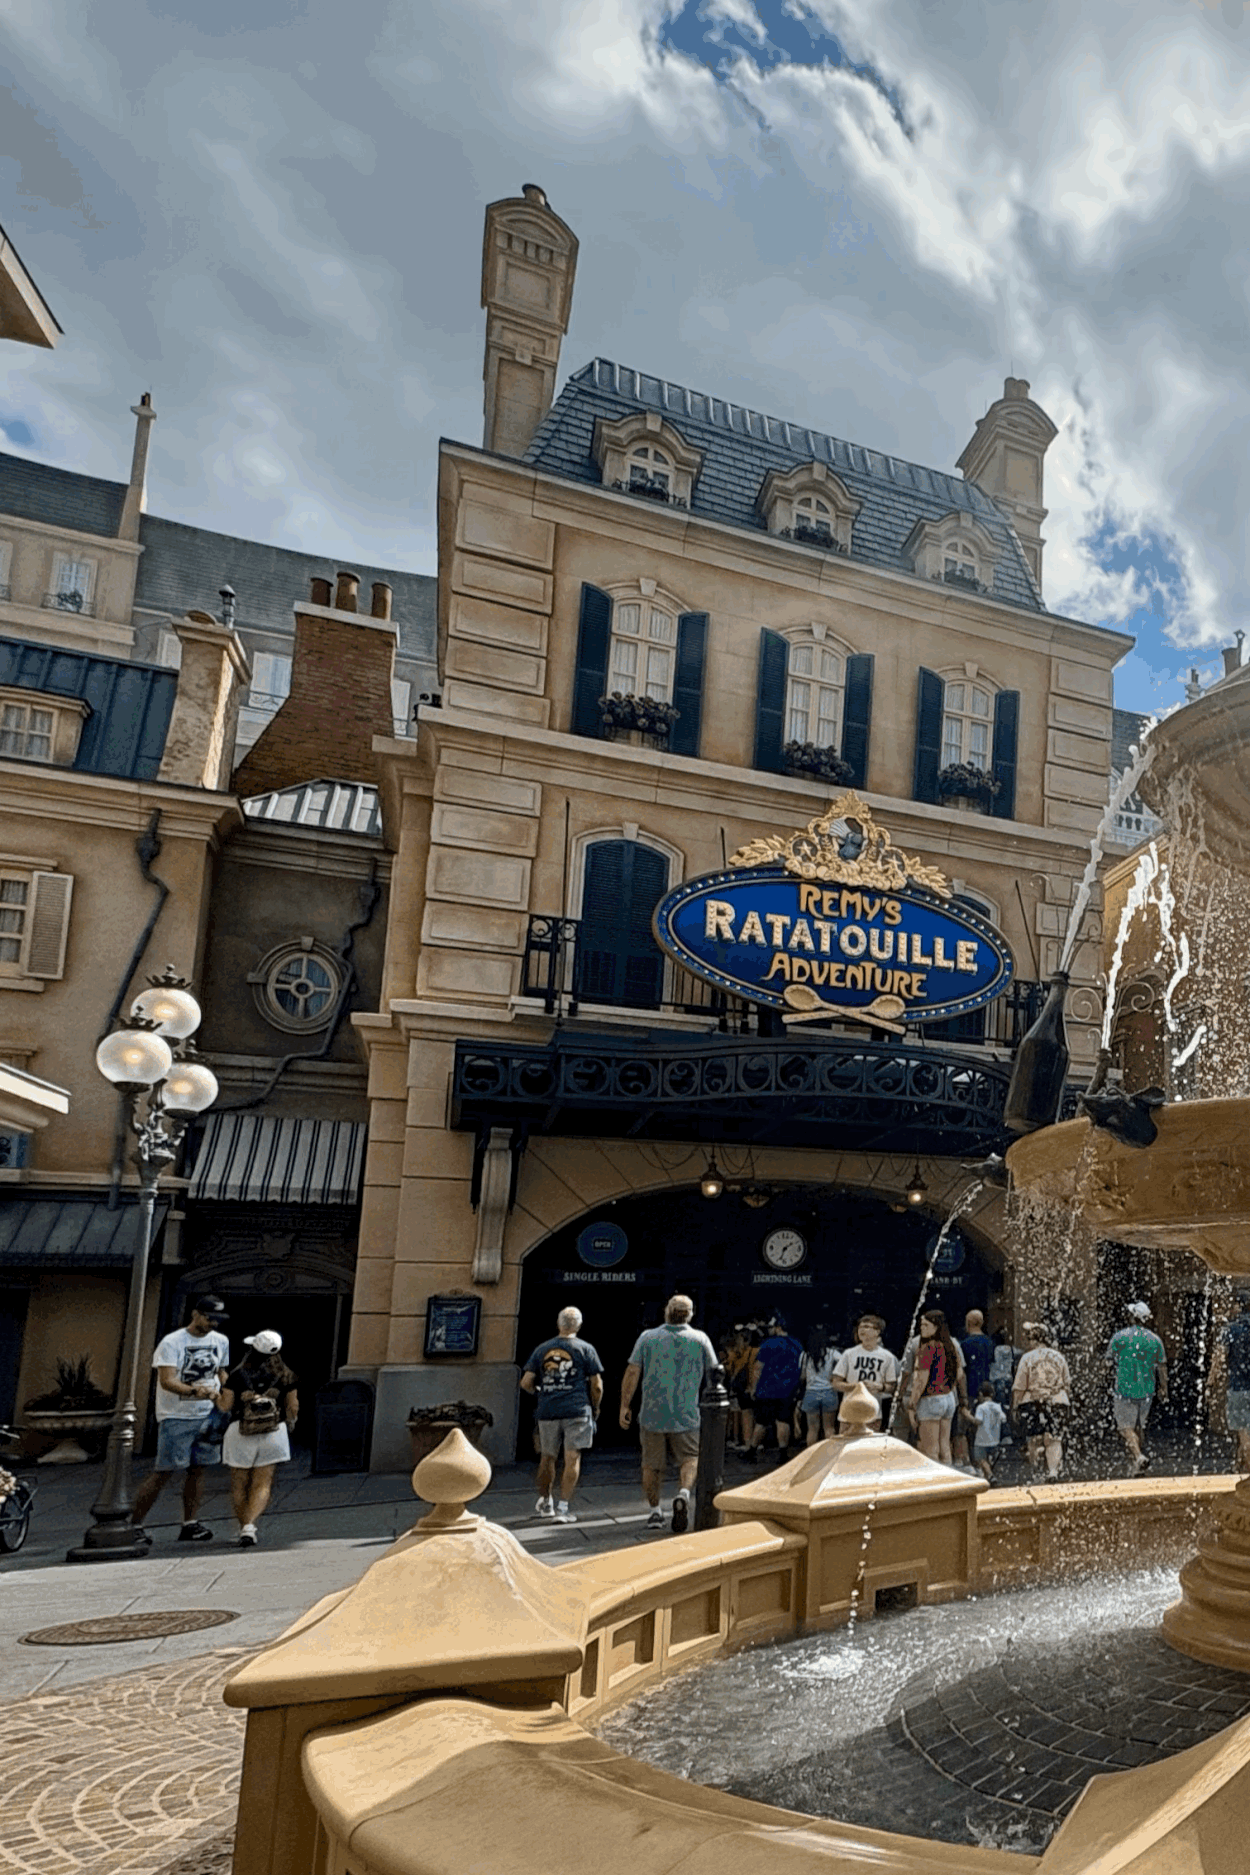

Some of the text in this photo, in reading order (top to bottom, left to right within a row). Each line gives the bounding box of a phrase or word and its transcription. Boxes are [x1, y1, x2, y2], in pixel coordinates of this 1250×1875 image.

[800, 883, 902, 926] REMY'S
[705, 899, 979, 974] RATATOUILLE
[761, 952, 928, 999] ADVENTURE
[563, 1271, 636, 1282] SINGLE RIDERS
[854, 1356, 884, 1371] JUST
[858, 1370, 876, 1382] DO
